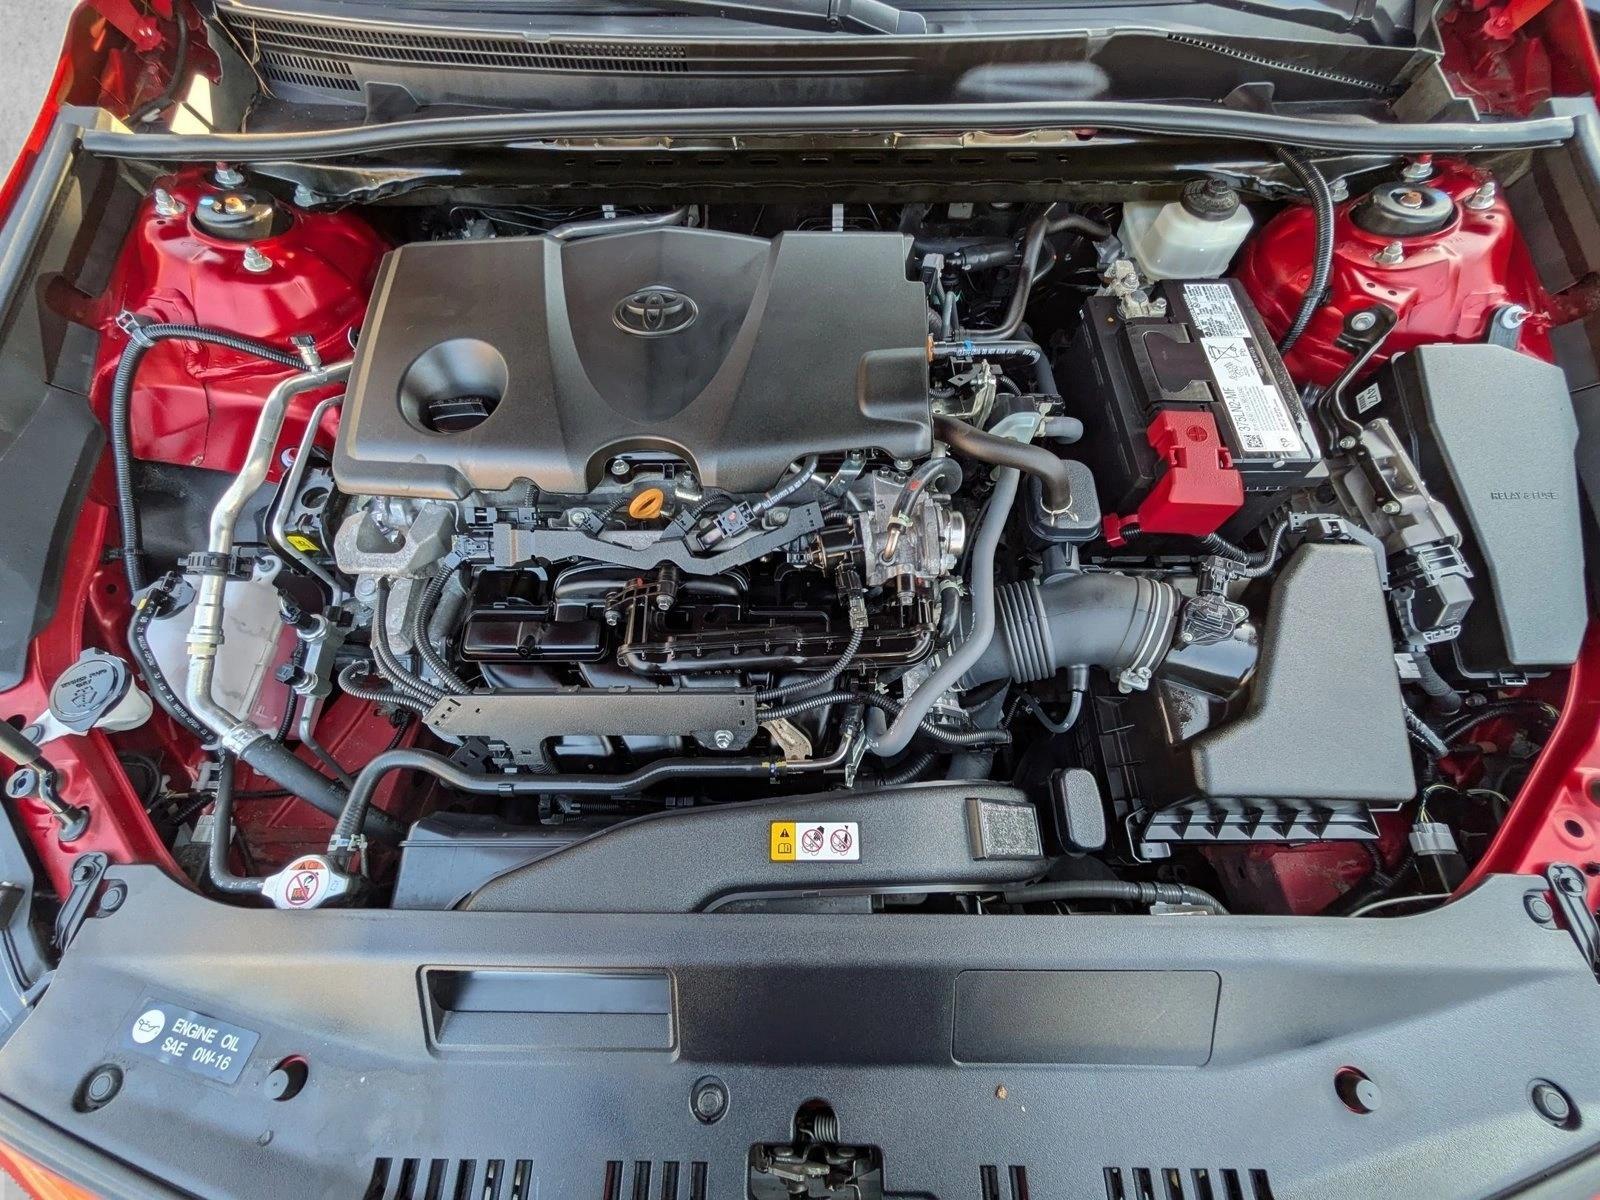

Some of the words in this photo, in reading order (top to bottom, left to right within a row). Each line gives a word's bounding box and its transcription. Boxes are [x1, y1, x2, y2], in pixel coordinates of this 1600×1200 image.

[1491, 492, 1521, 500] RELAY
[1532, 492, 1558, 500] FUSE
[172, 1019, 218, 1043] ENGINE
[220, 1034, 240, 1052] OIL
[161, 1036, 188, 1057] SAE
[192, 1047, 231, 1070] 0W-16
